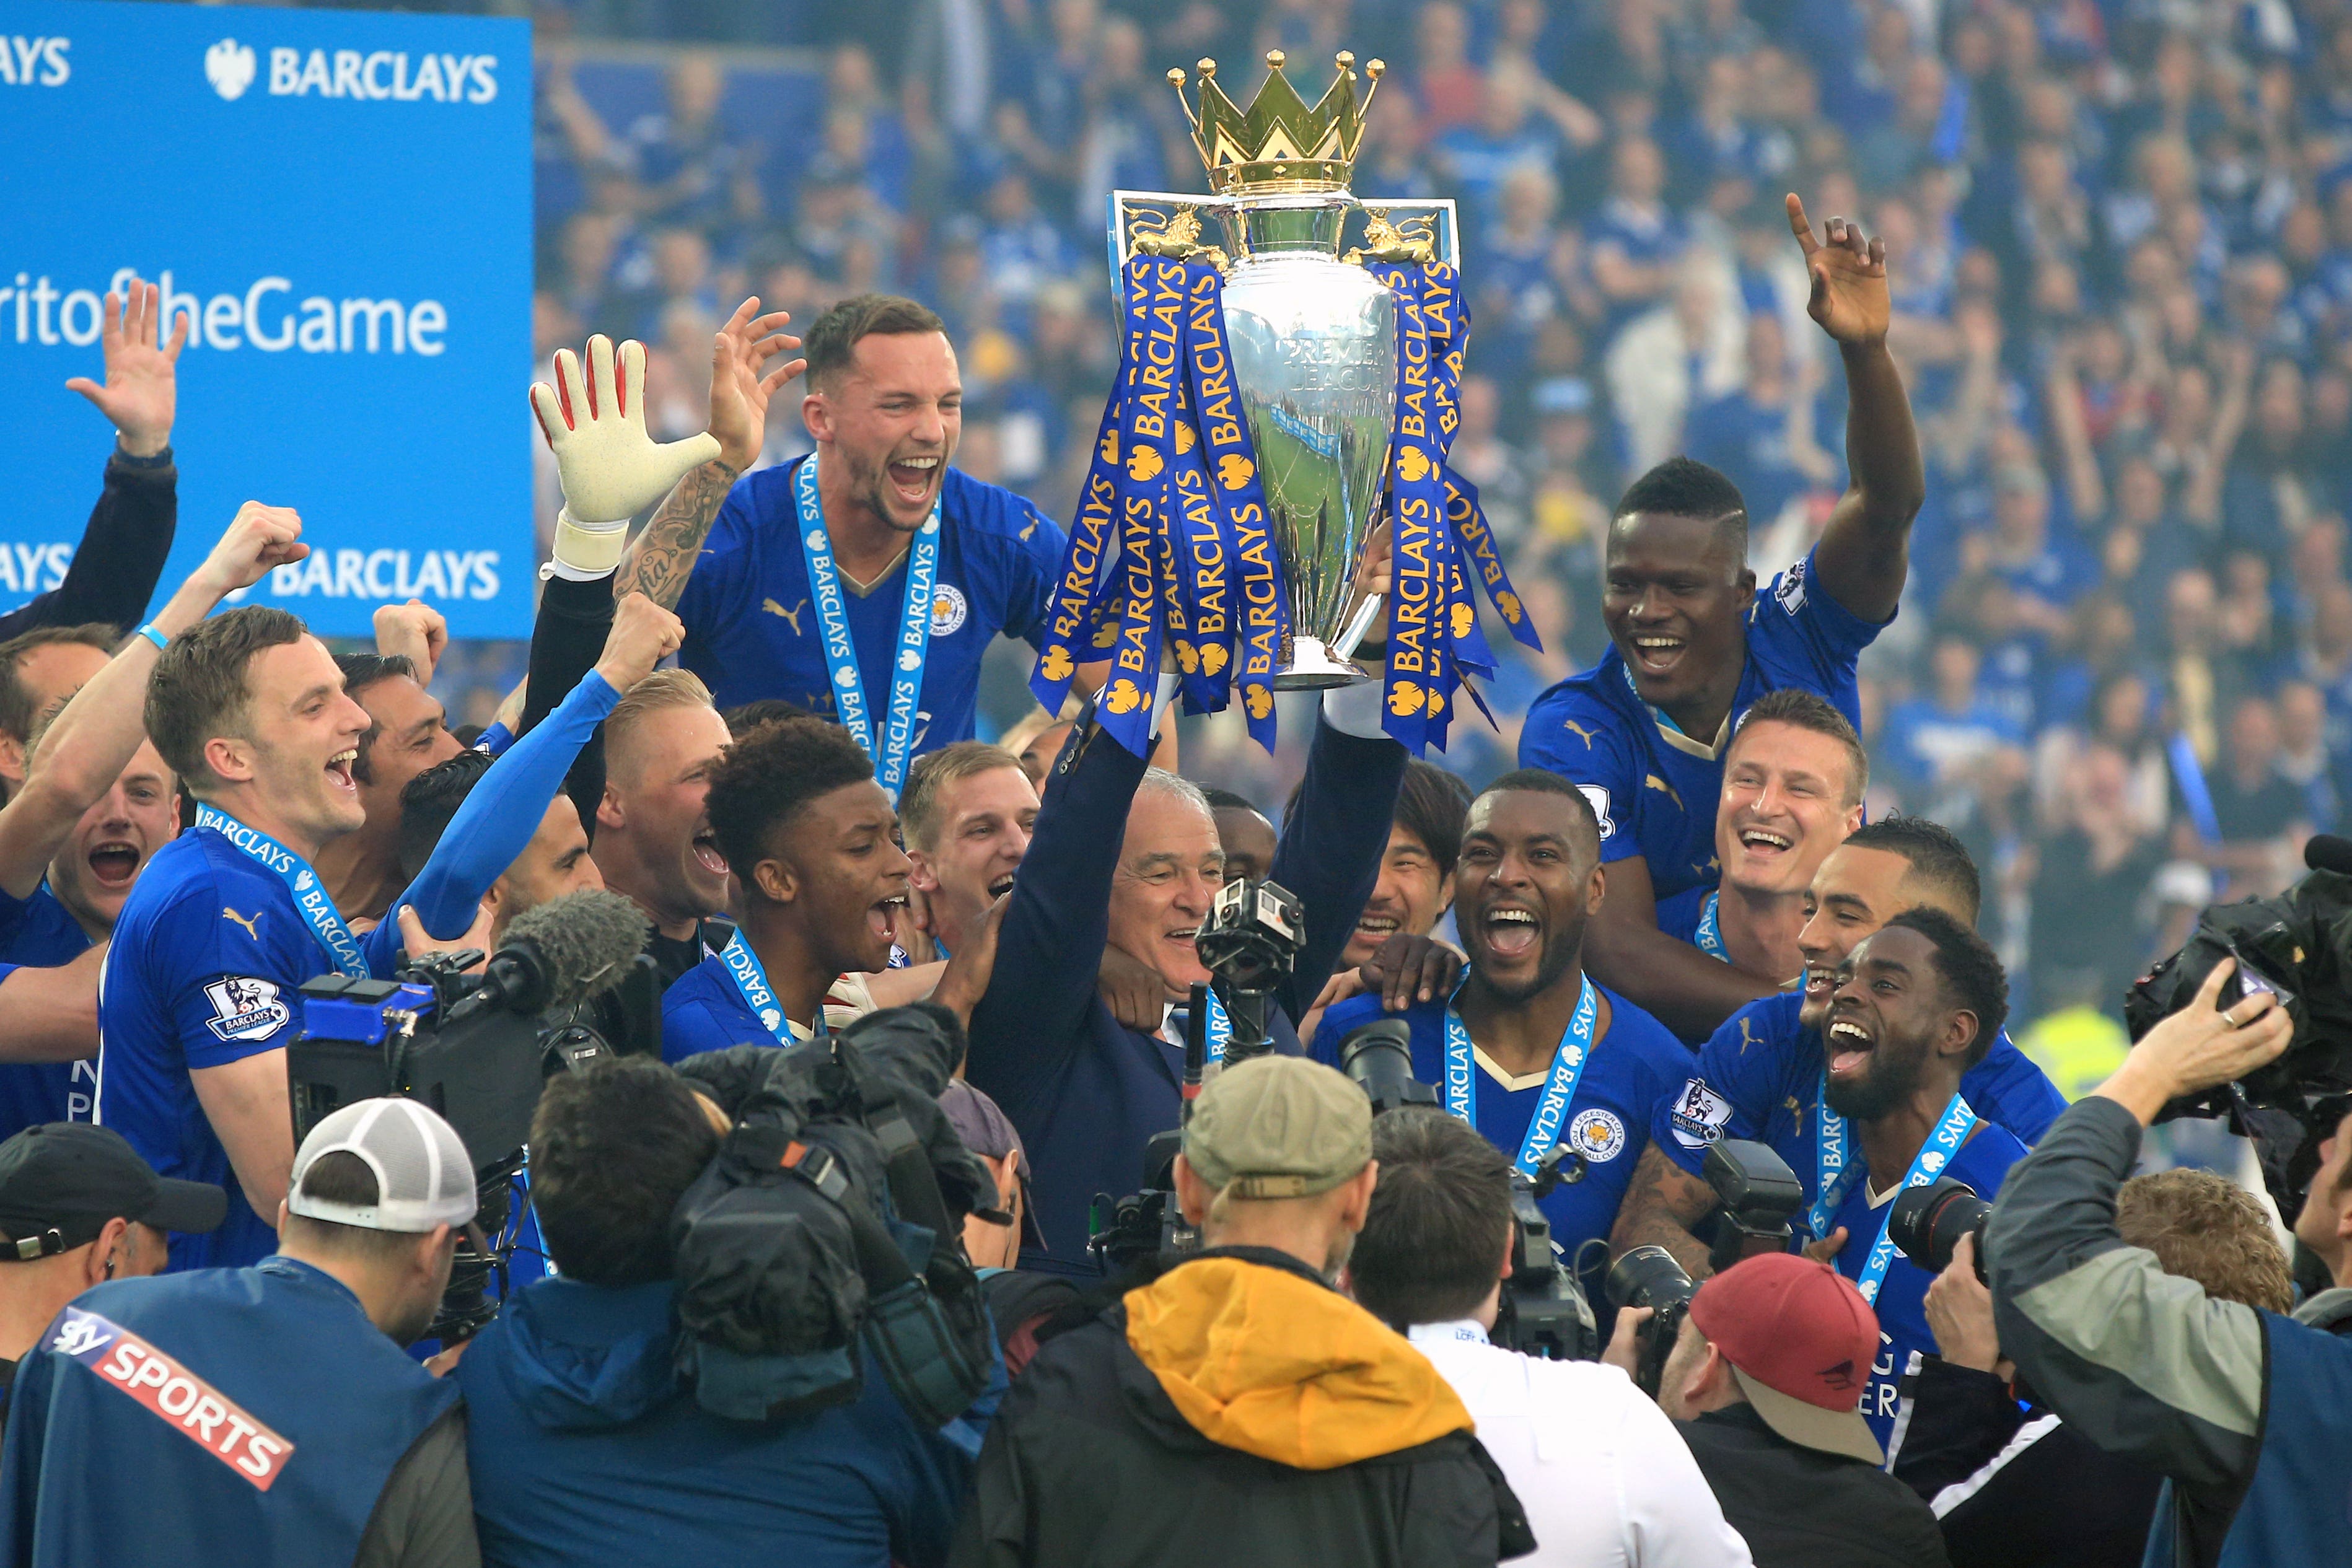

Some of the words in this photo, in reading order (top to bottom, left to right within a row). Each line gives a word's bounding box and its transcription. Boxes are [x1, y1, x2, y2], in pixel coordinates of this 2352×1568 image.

[269, 46, 498, 103] BARCLAYS
[1134, 263, 1187, 439] BARCLAYS
[1190, 274, 1242, 446] BARCLAYS
[271, 548, 500, 601] BARCLAYS
[903, 543, 934, 647] BARCLAYS
[1054, 473, 1115, 638] BARCLAYS
[1118, 496, 1153, 673] BARCLAYS
[1175, 469, 1227, 635] BARCLAYS
[1231, 502, 1277, 675] BARCLAYS
[1393, 497, 1430, 673] BARCLAYS
[812, 556, 850, 658] BARCLAYS
[841, 692, 871, 751] BARC
[884, 680, 915, 784] BARCLAYS
[201, 810, 296, 874] BARCLAYS
[301, 890, 368, 982] BARCLAYS
[225, 1009, 270, 1030] BARCLAYS
[1525, 1066, 1575, 1165] BARCLAYS
[1575, 1111, 1616, 1127] LEICESTER
[1614, 1123, 1623, 1141] CITY
[1602, 1144, 1620, 1159] CLUB
[53, 1314, 112, 1356] sky
[103, 1342, 282, 1477] SPORTS
